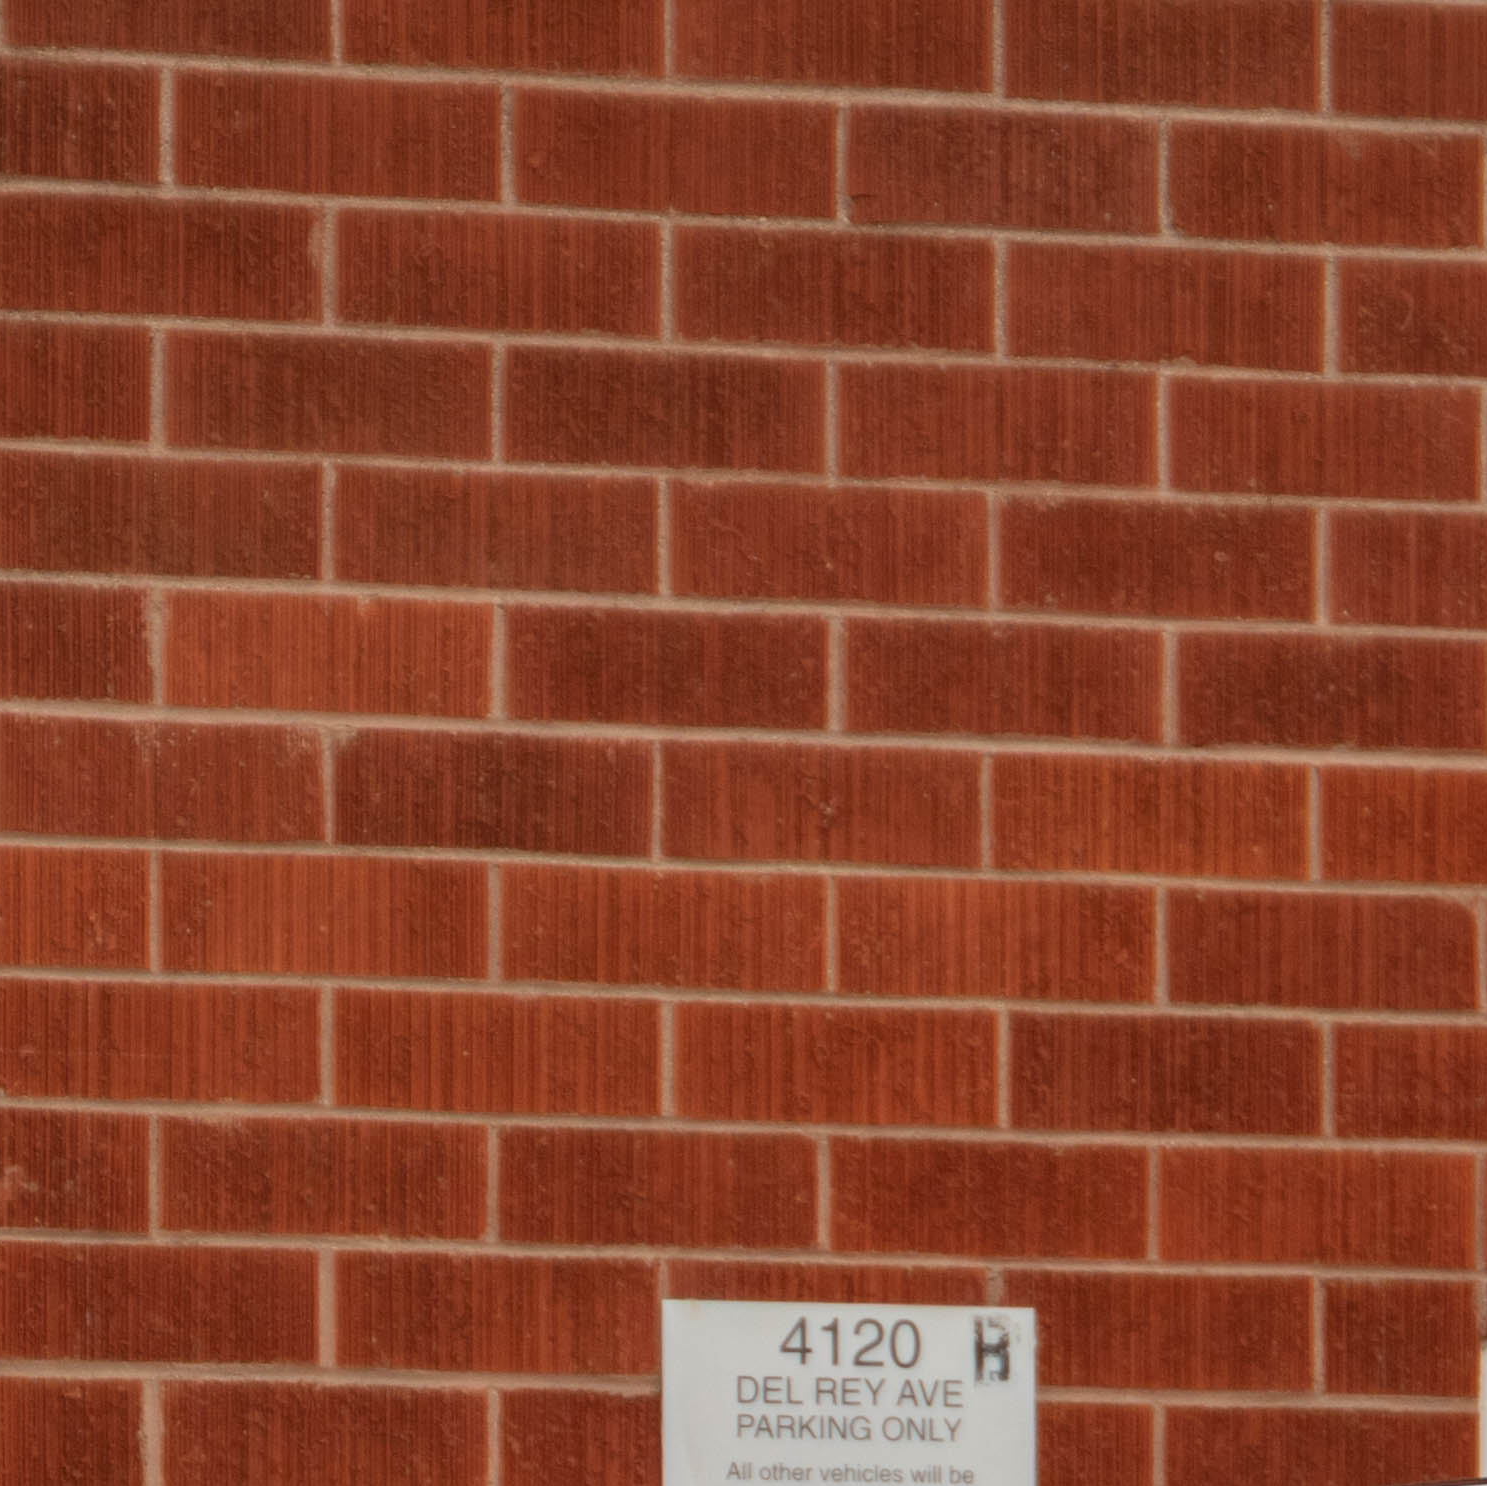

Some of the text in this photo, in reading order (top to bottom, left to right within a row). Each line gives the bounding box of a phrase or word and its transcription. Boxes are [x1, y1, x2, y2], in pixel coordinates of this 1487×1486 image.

[779, 1316, 922, 1368] 4120
[737, 1375, 964, 1408] DEL REY AVE
[736, 1413, 962, 1442] PARKING ONLY
[725, 1461, 975, 1485] All other vehicles will be
